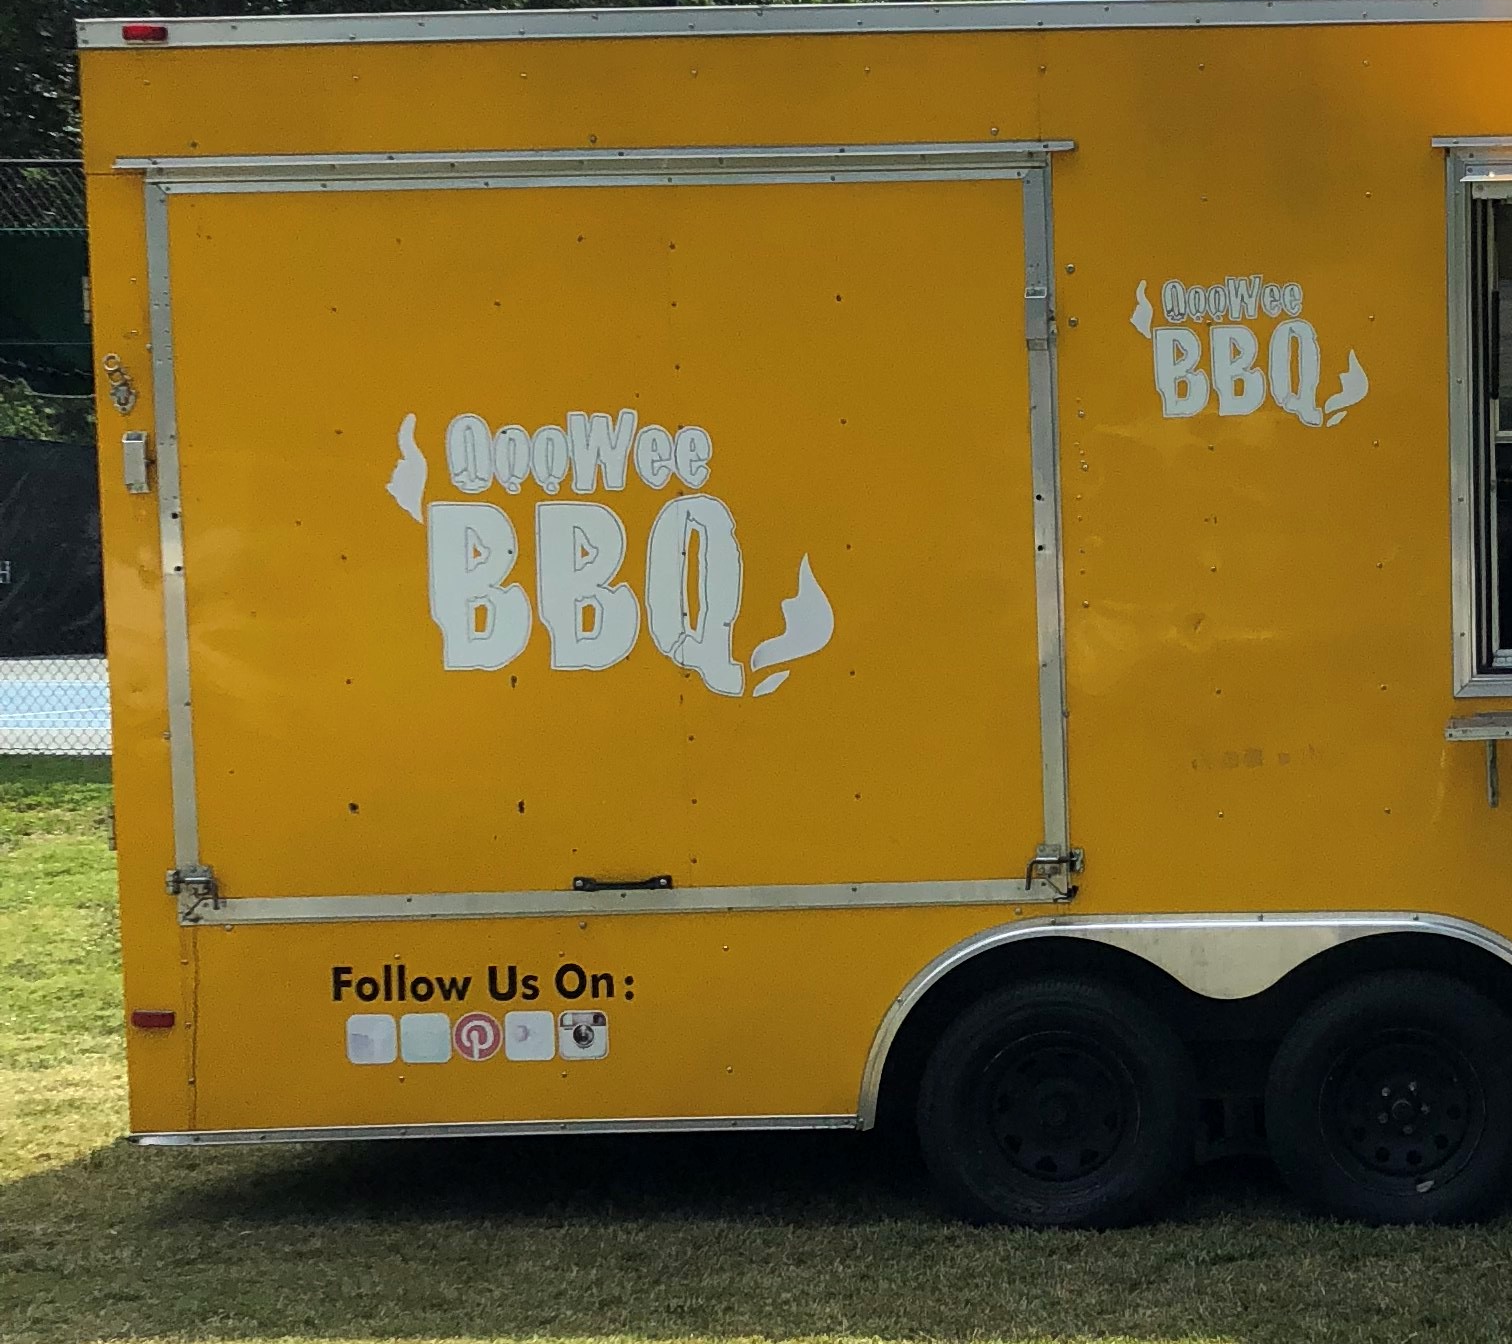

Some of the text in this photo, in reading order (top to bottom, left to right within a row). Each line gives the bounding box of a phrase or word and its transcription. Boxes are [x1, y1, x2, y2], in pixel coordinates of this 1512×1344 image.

[1153, 318, 1323, 427] BBQ
[445, 408, 712, 494] OooWee
[427, 494, 744, 697] BBQ
[332, 963, 634, 1002] Follow Us On:
